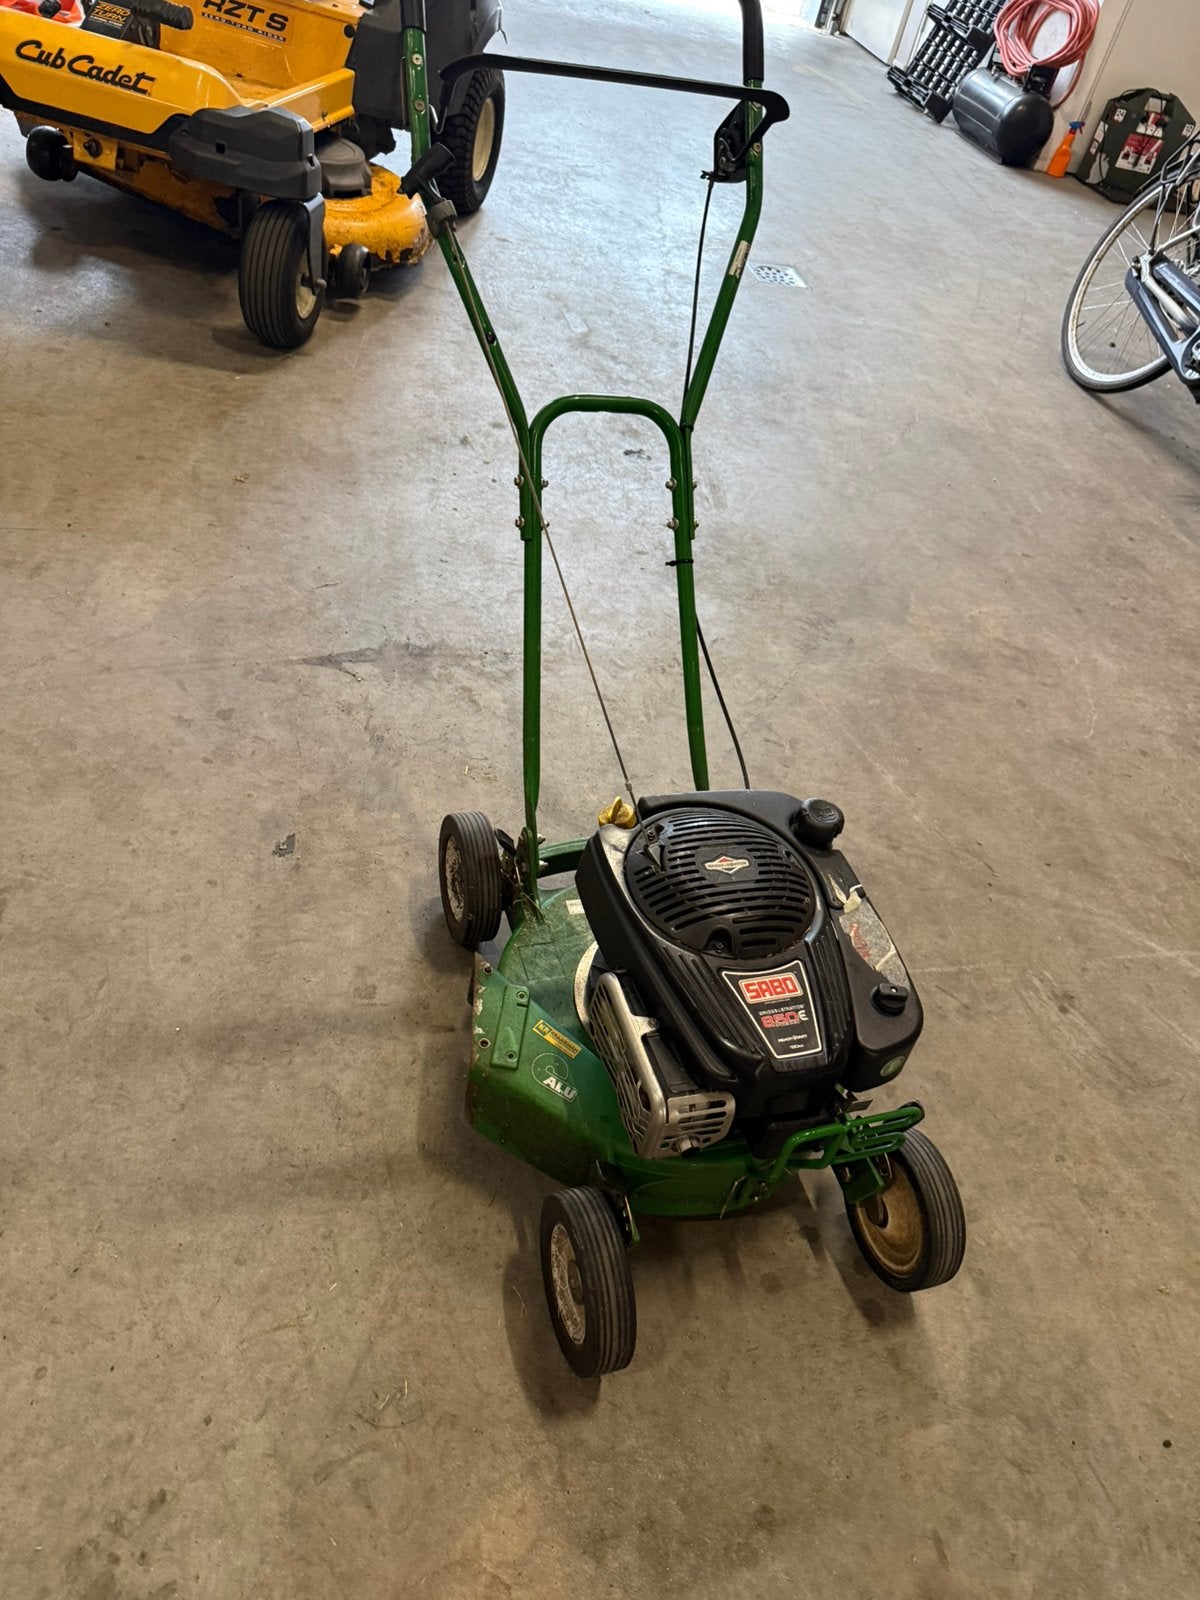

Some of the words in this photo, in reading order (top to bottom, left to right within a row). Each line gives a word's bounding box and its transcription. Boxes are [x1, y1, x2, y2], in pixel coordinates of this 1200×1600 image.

[92, 9, 127, 23] TURN
[95, 3, 131, 17] ZERO
[203, 0, 265, 23] RZT
[265, 12, 289, 32] S
[15, 39, 65, 70] Cub
[67, 54, 156, 96] Cadet
[744, 976, 798, 999] SABO
[543, 1076, 577, 1099] ALU
